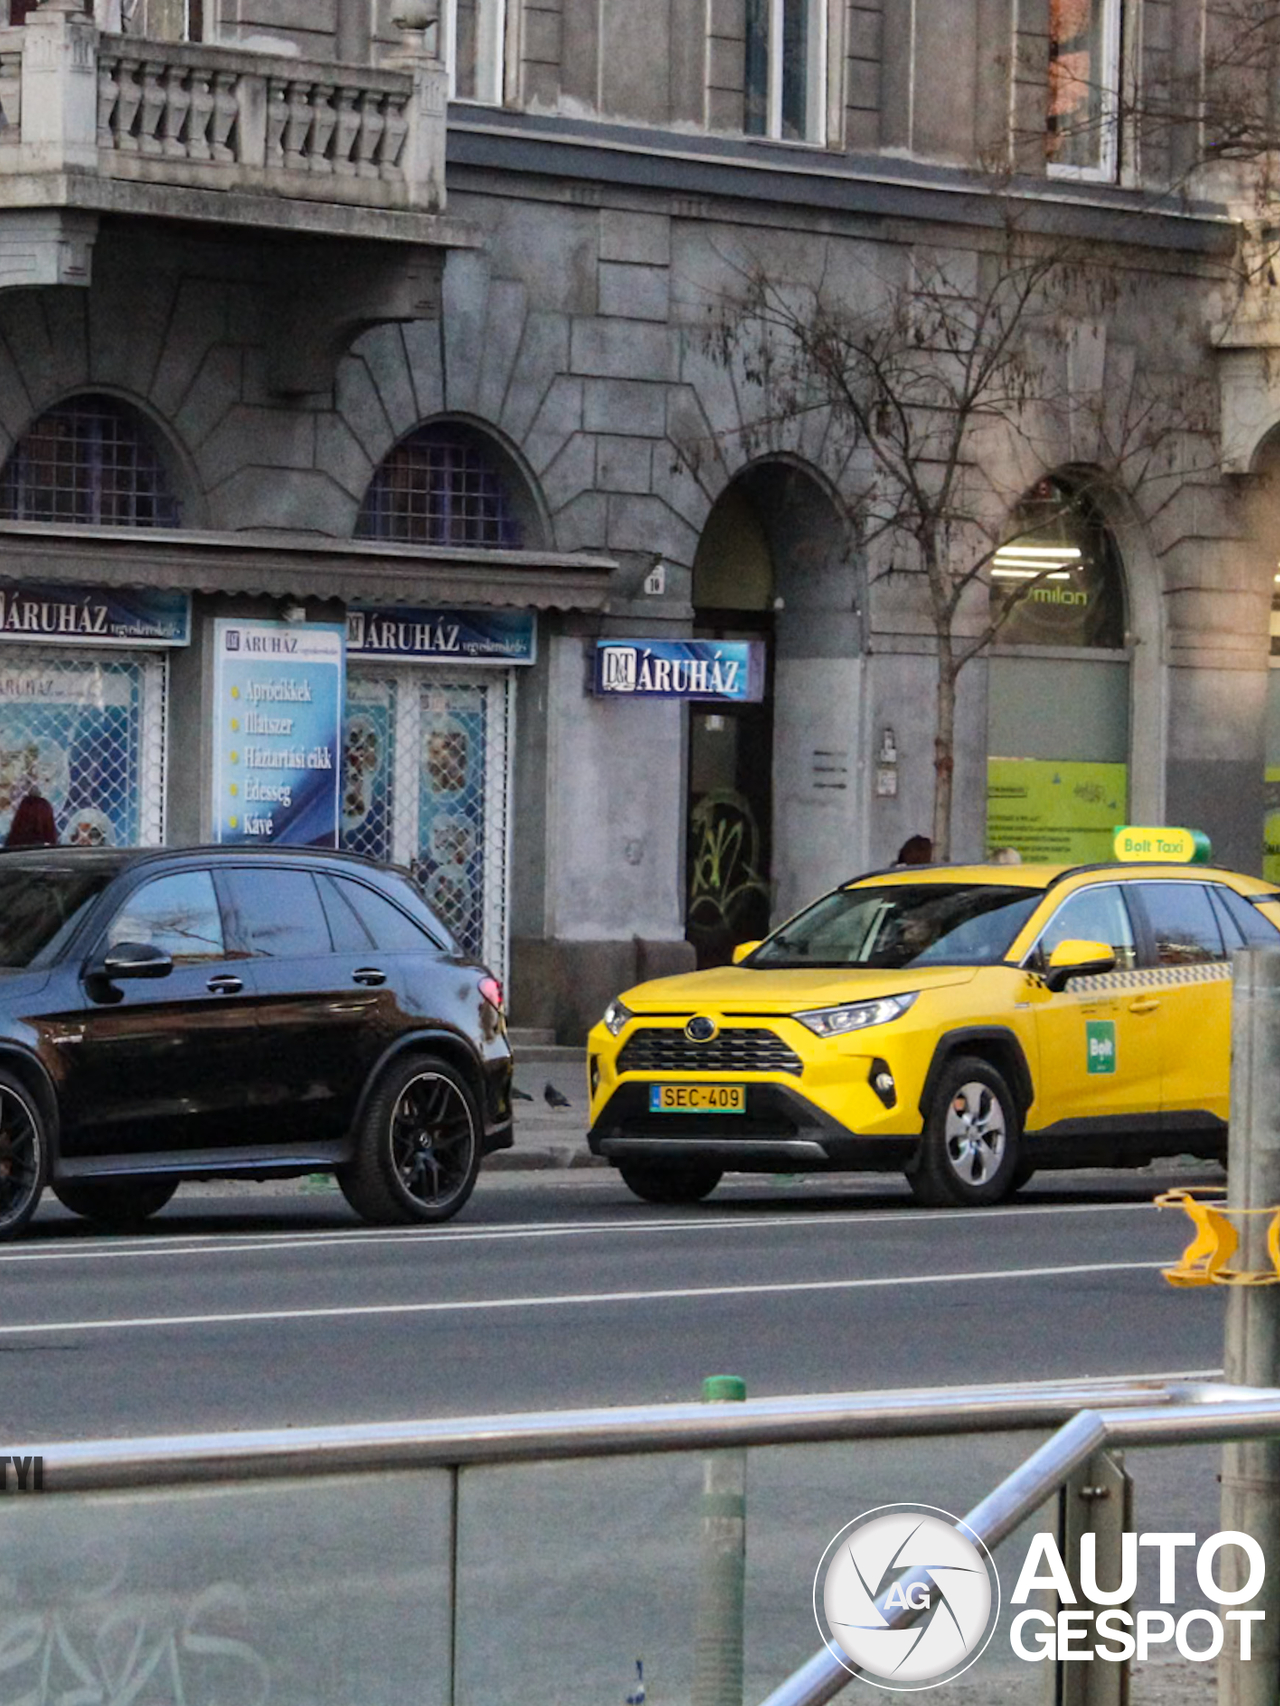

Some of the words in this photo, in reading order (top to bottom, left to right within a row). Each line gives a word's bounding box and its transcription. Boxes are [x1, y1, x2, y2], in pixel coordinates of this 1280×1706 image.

[5, 592, 109, 634] ÁRUHÁZ
[243, 632, 299, 654] ÁRUHÁZ
[365, 613, 460, 652] ÁRUHÁZ
[636, 648, 739, 693] ÁRUHÁZ
[307, 746, 332, 769] cikk
[244, 774, 293, 807] Édesség
[244, 812, 274, 835] Kávé
[1125, 838, 1151, 853] Bolt
[1156, 838, 1184, 854] Taxi
[1090, 1038, 1113, 1056] Bolt
[664, 1088, 739, 1107] SEC-409
